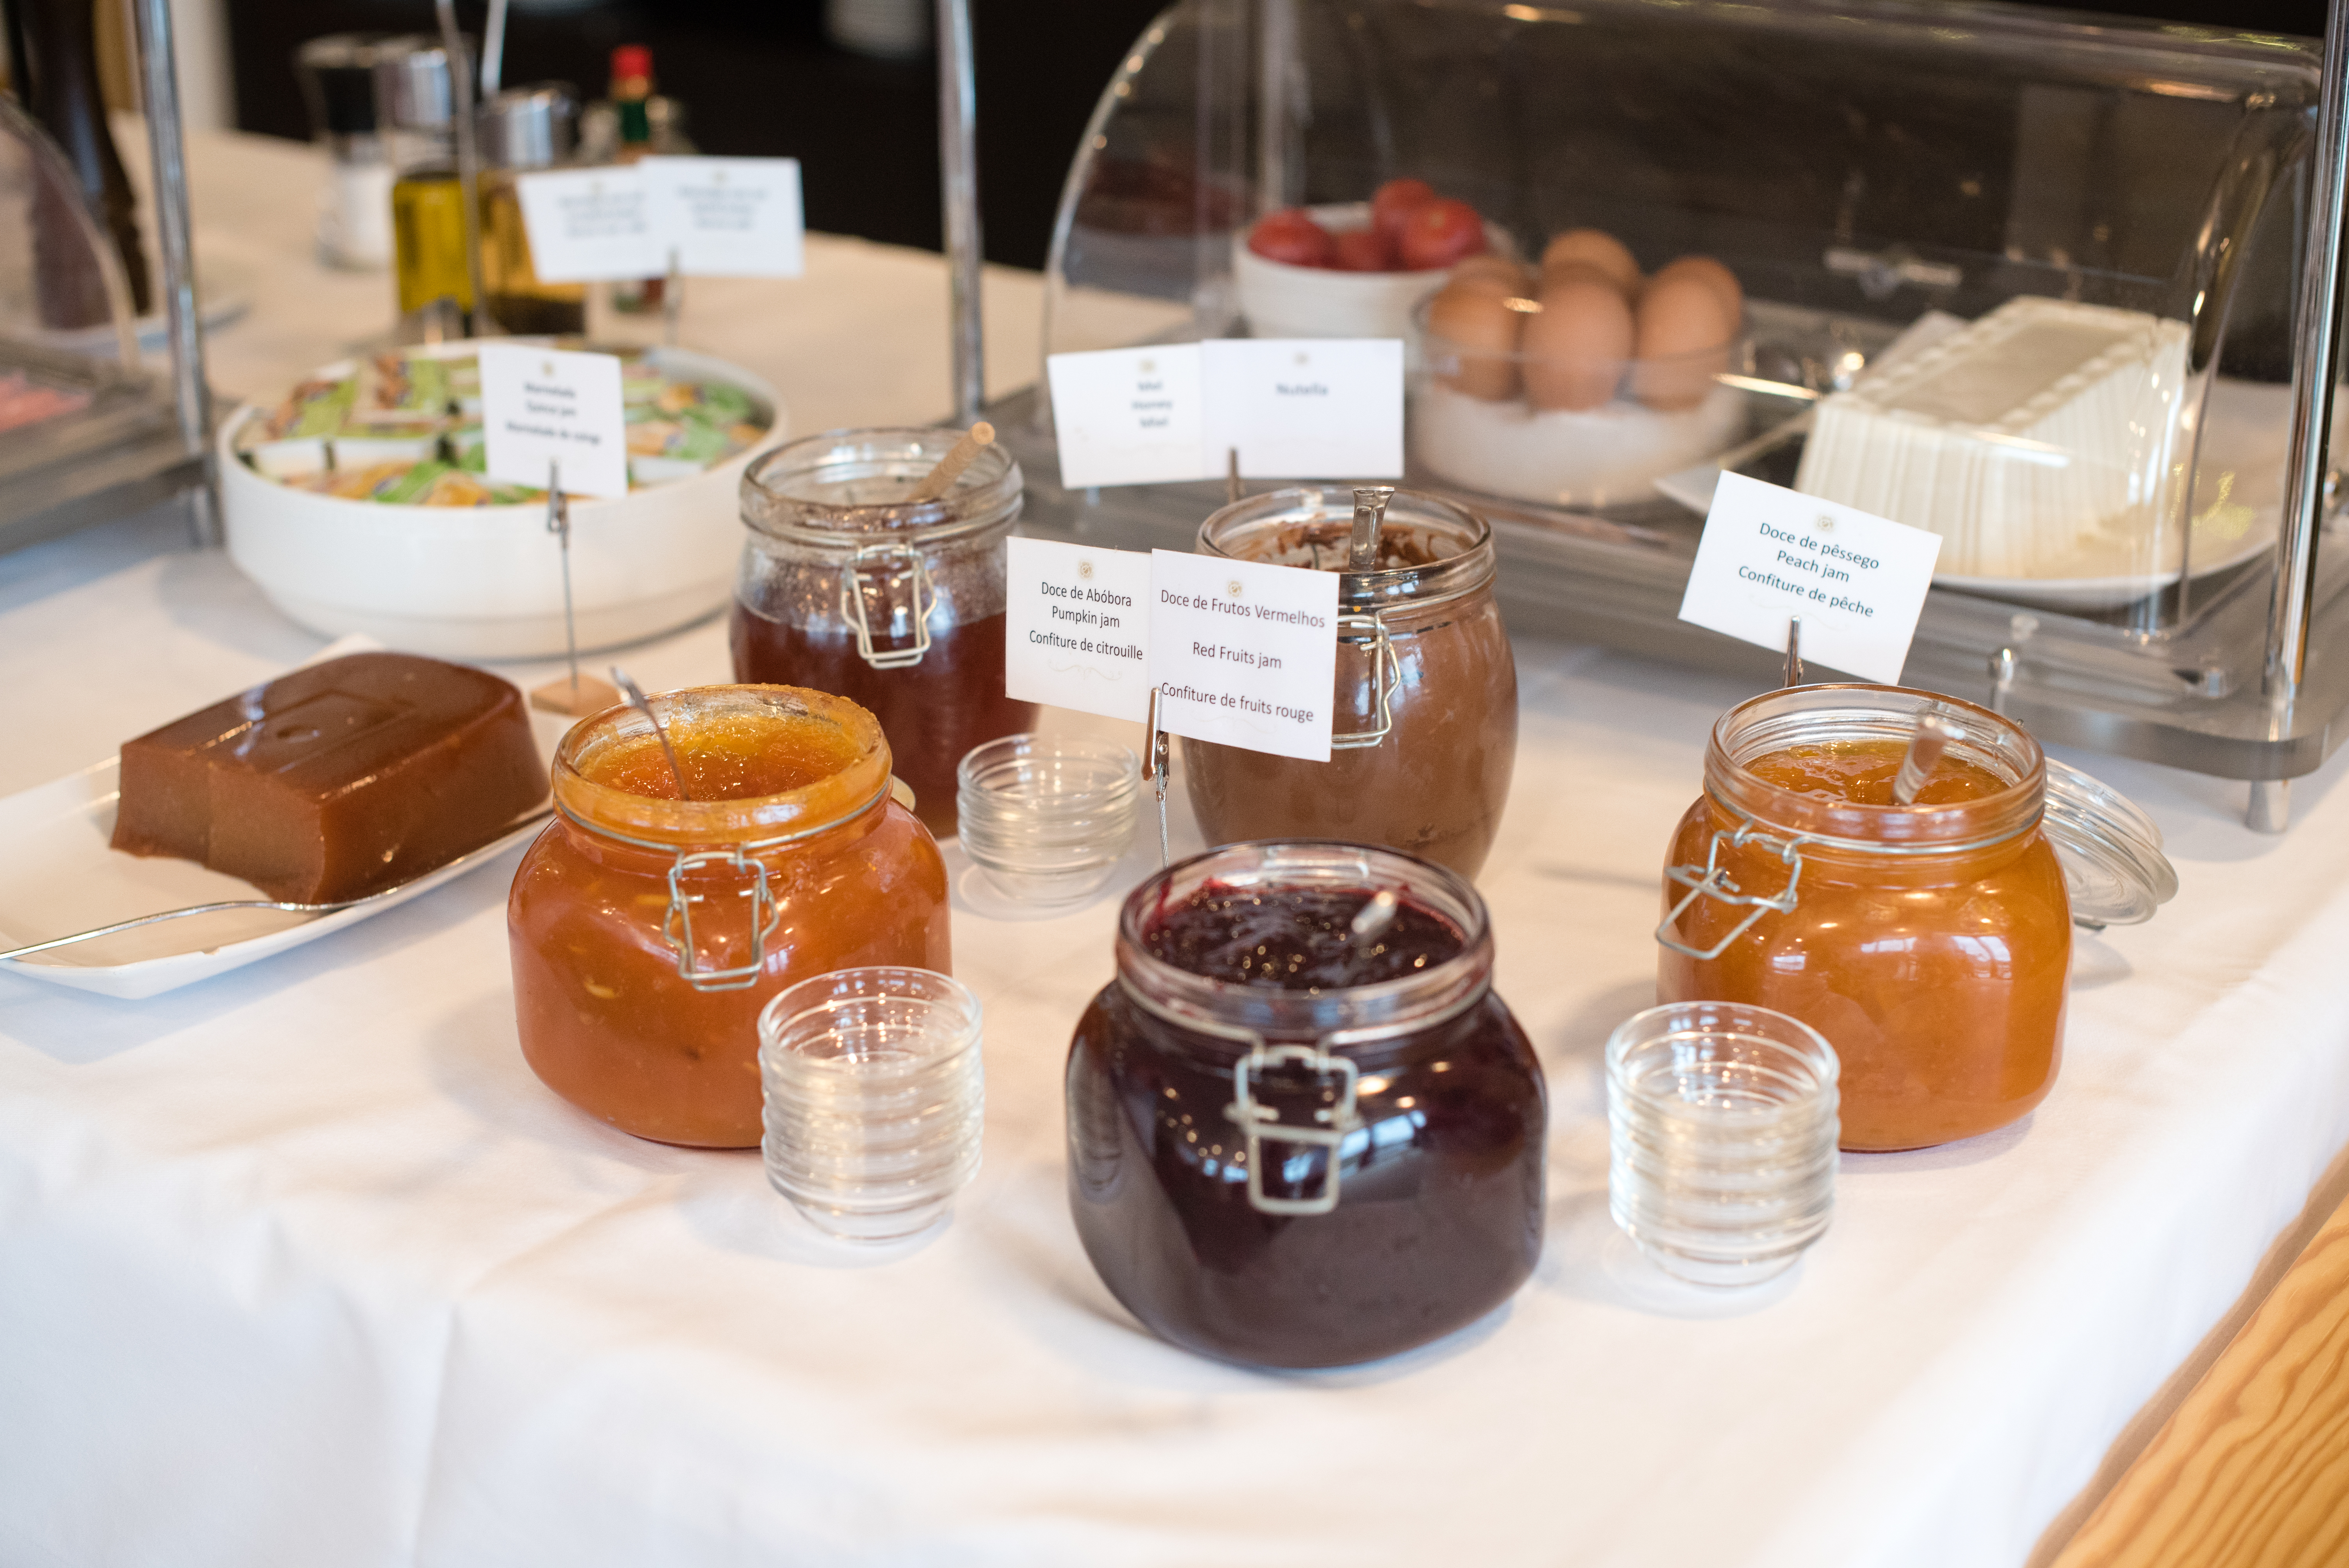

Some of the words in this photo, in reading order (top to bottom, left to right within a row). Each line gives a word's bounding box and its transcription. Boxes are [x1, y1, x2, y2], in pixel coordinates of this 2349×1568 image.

[1759, 522, 1795, 543] Doce
[1799, 536, 1818, 550] de
[1820, 544, 1879, 569] pêssego
[1777, 550, 1819, 573] Peach
[1821, 564, 1850, 583] jam
[1041, 581, 1067, 598] Doce
[1070, 585, 1084, 600] de
[1086, 588, 1132, 607] Abóbora
[1739, 566, 1805, 595] Confiture
[1808, 588, 1826, 602] de
[1829, 597, 1873, 617] pêche
[1052, 605, 1097, 625] Pumpkin
[1099, 612, 1120, 629] jam
[1161, 589, 1189, 607] Doce
[1193, 595, 1208, 610] de
[1212, 598, 1251, 617] Frutos
[1255, 605, 1325, 628] Vermelhos
[1029, 630, 1077, 650] Confiture
[1080, 638, 1093, 652] de
[1096, 641, 1143, 660] citrouille
[1193, 641, 1215, 658] Red
[1220, 646, 1255, 665] Fruits
[1257, 653, 1281, 669] jam
[1162, 682, 1216, 705] Confiture
[1220, 693, 1236, 708] de
[1240, 695, 1272, 715] fruits
[1276, 706, 1314, 723] rouge
